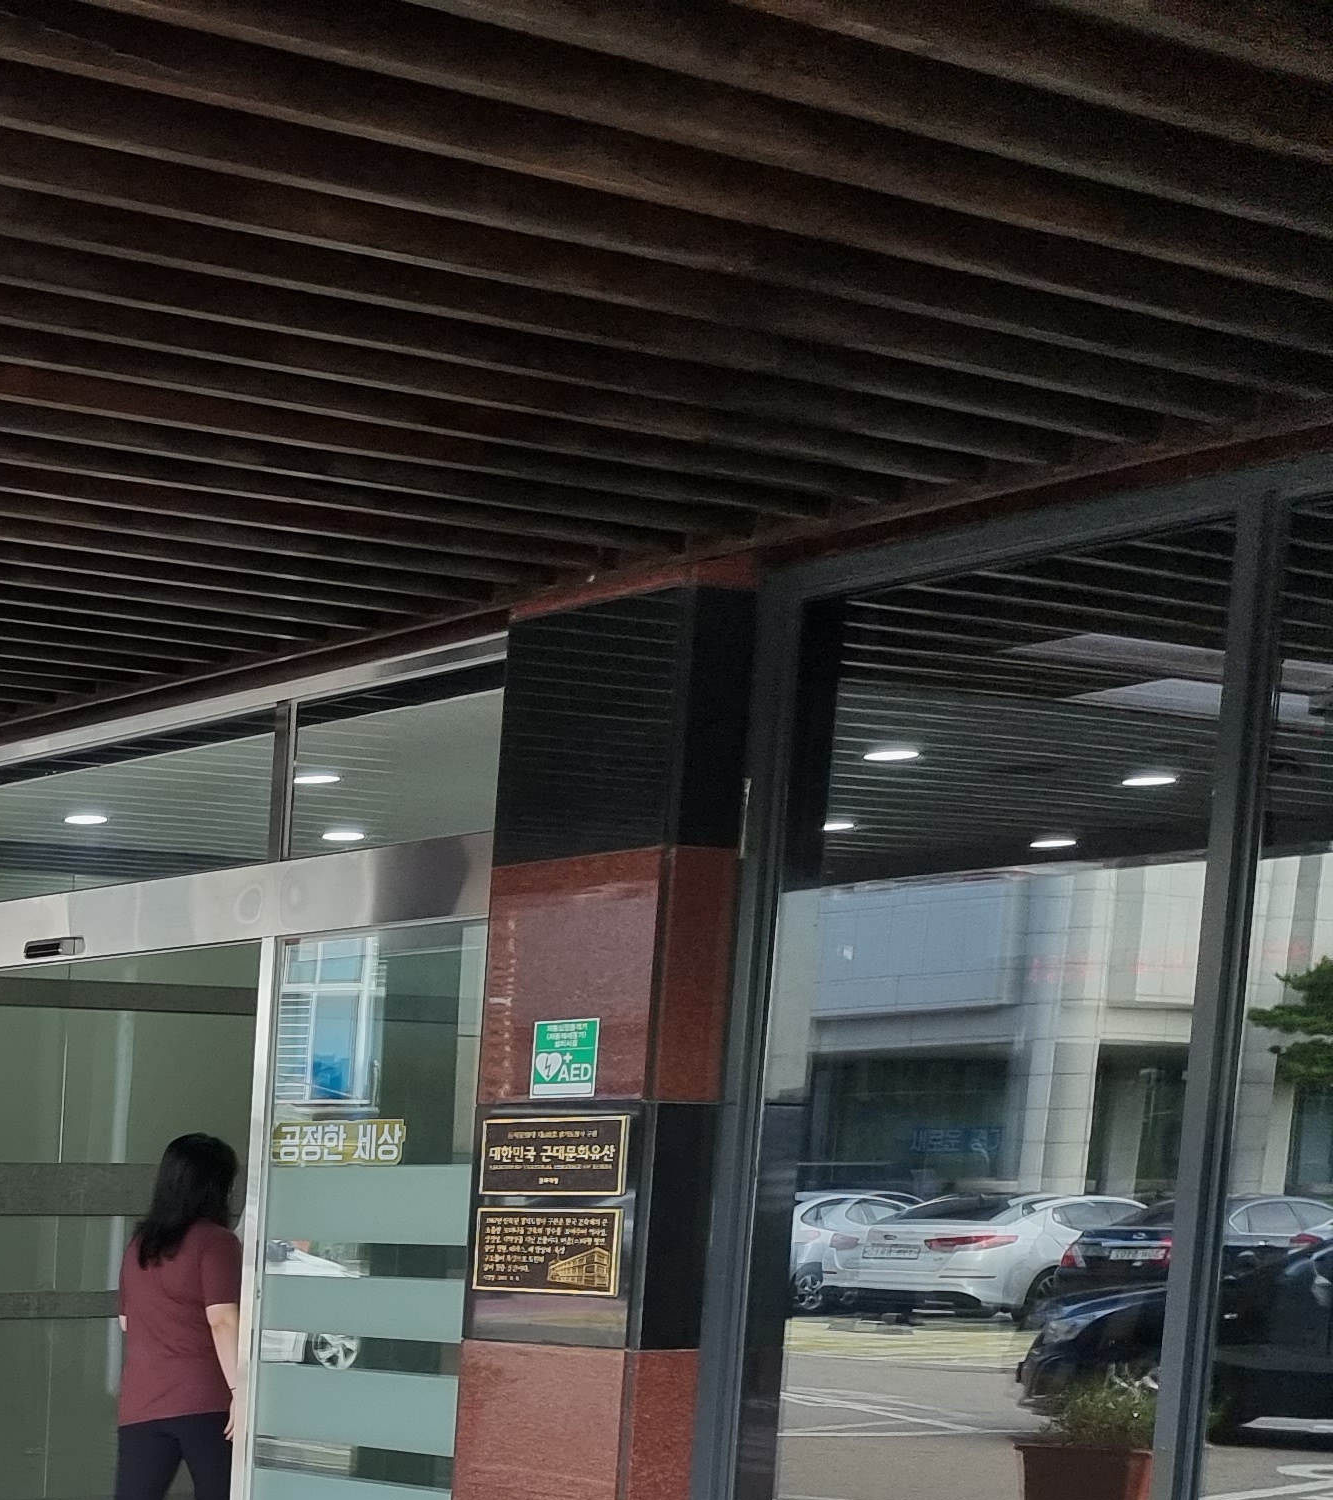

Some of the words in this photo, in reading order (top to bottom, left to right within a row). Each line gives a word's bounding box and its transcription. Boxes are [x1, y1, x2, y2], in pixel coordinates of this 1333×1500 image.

[557, 1063, 592, 1082] AED
[279, 1124, 347, 1161] 공정한
[352, 1123, 402, 1161] 세상
[489, 1145, 536, 1162] 대한민국
[539, 1144, 616, 1162] 근대문화유산
